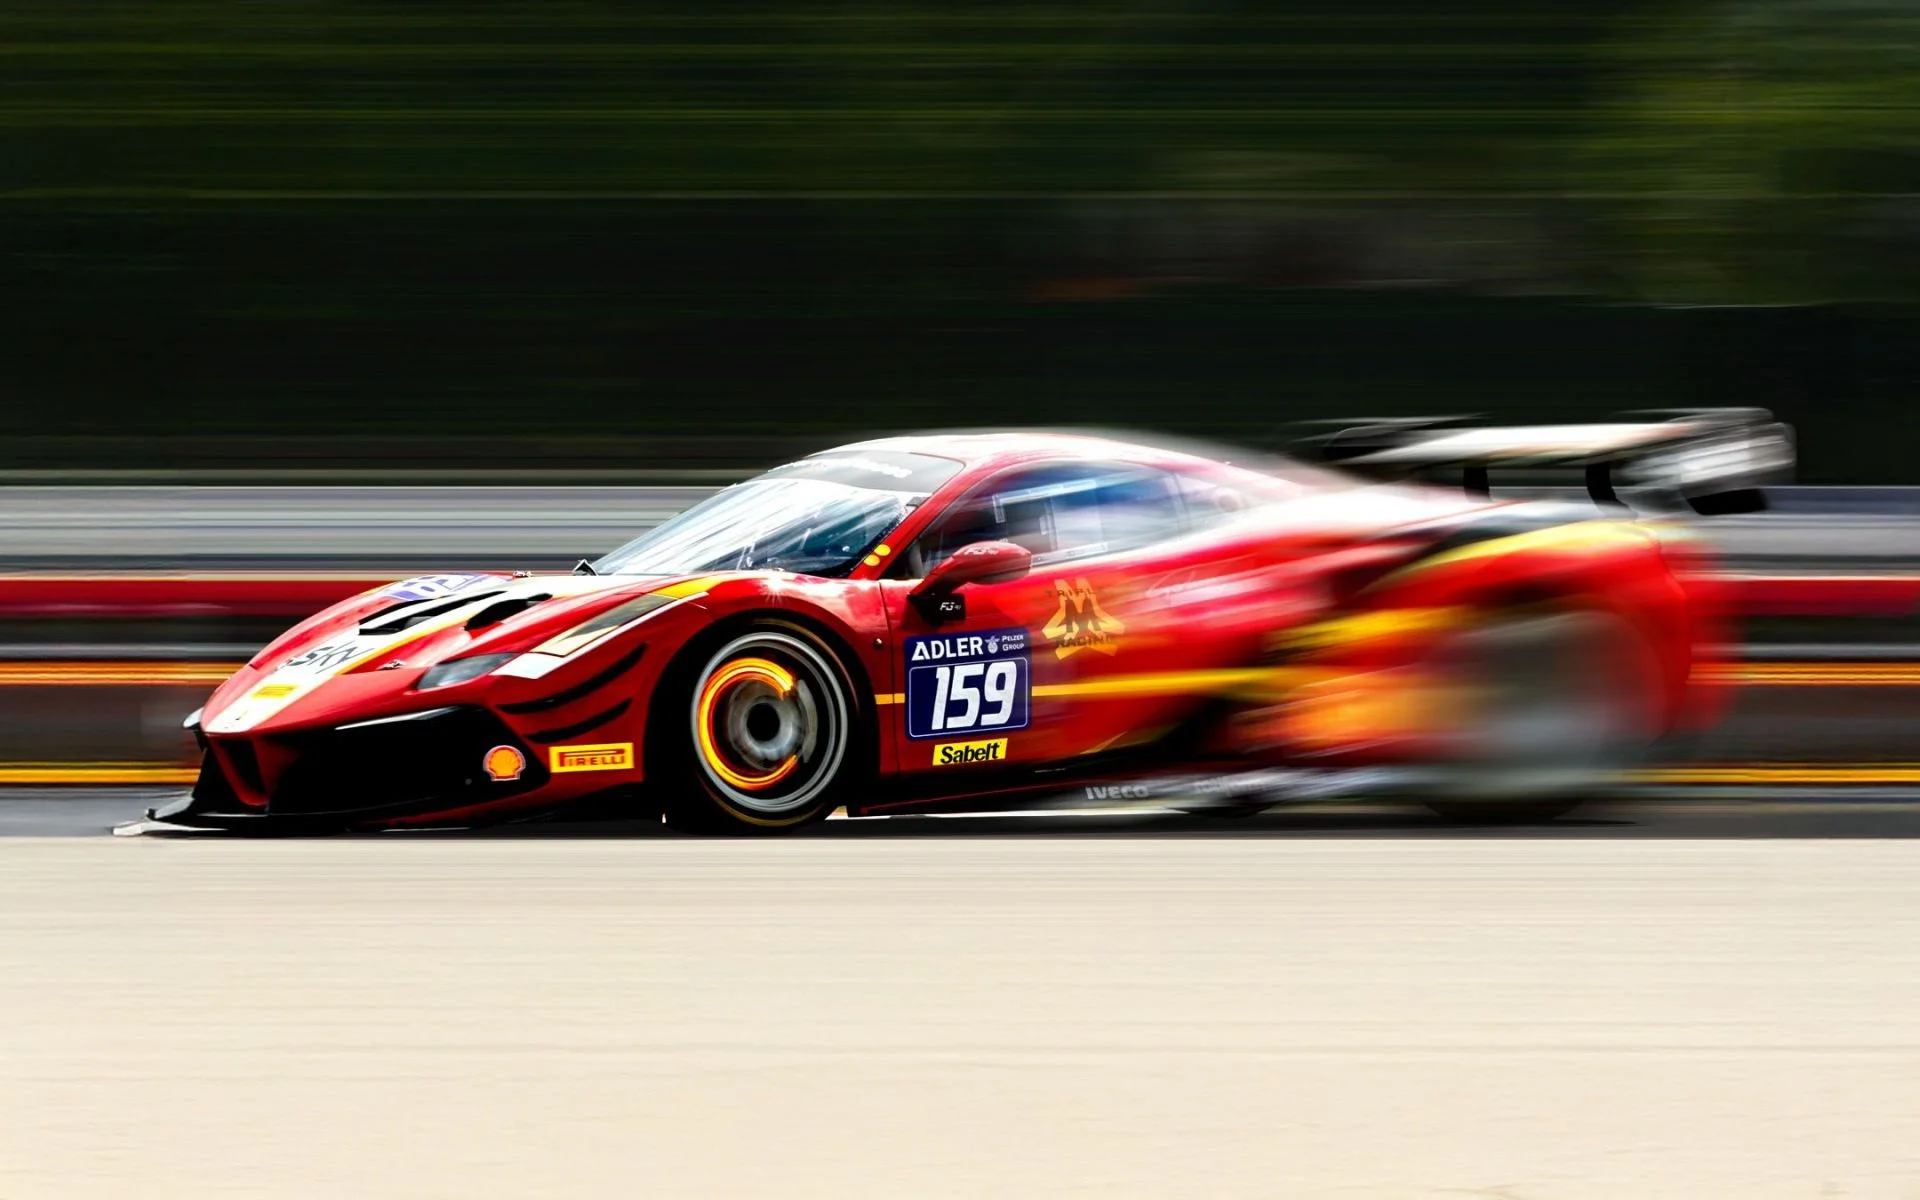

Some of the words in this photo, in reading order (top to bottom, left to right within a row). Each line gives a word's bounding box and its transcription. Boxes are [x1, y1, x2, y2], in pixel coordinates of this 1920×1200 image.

[911, 636, 983, 661] ADLER
[1002, 643, 1025, 651] GROUP
[931, 661, 1017, 731] 159
[559, 748, 625, 767] PIRELLI
[940, 742, 1000, 764] Sabelt
[1085, 785, 1149, 800] IVECO
